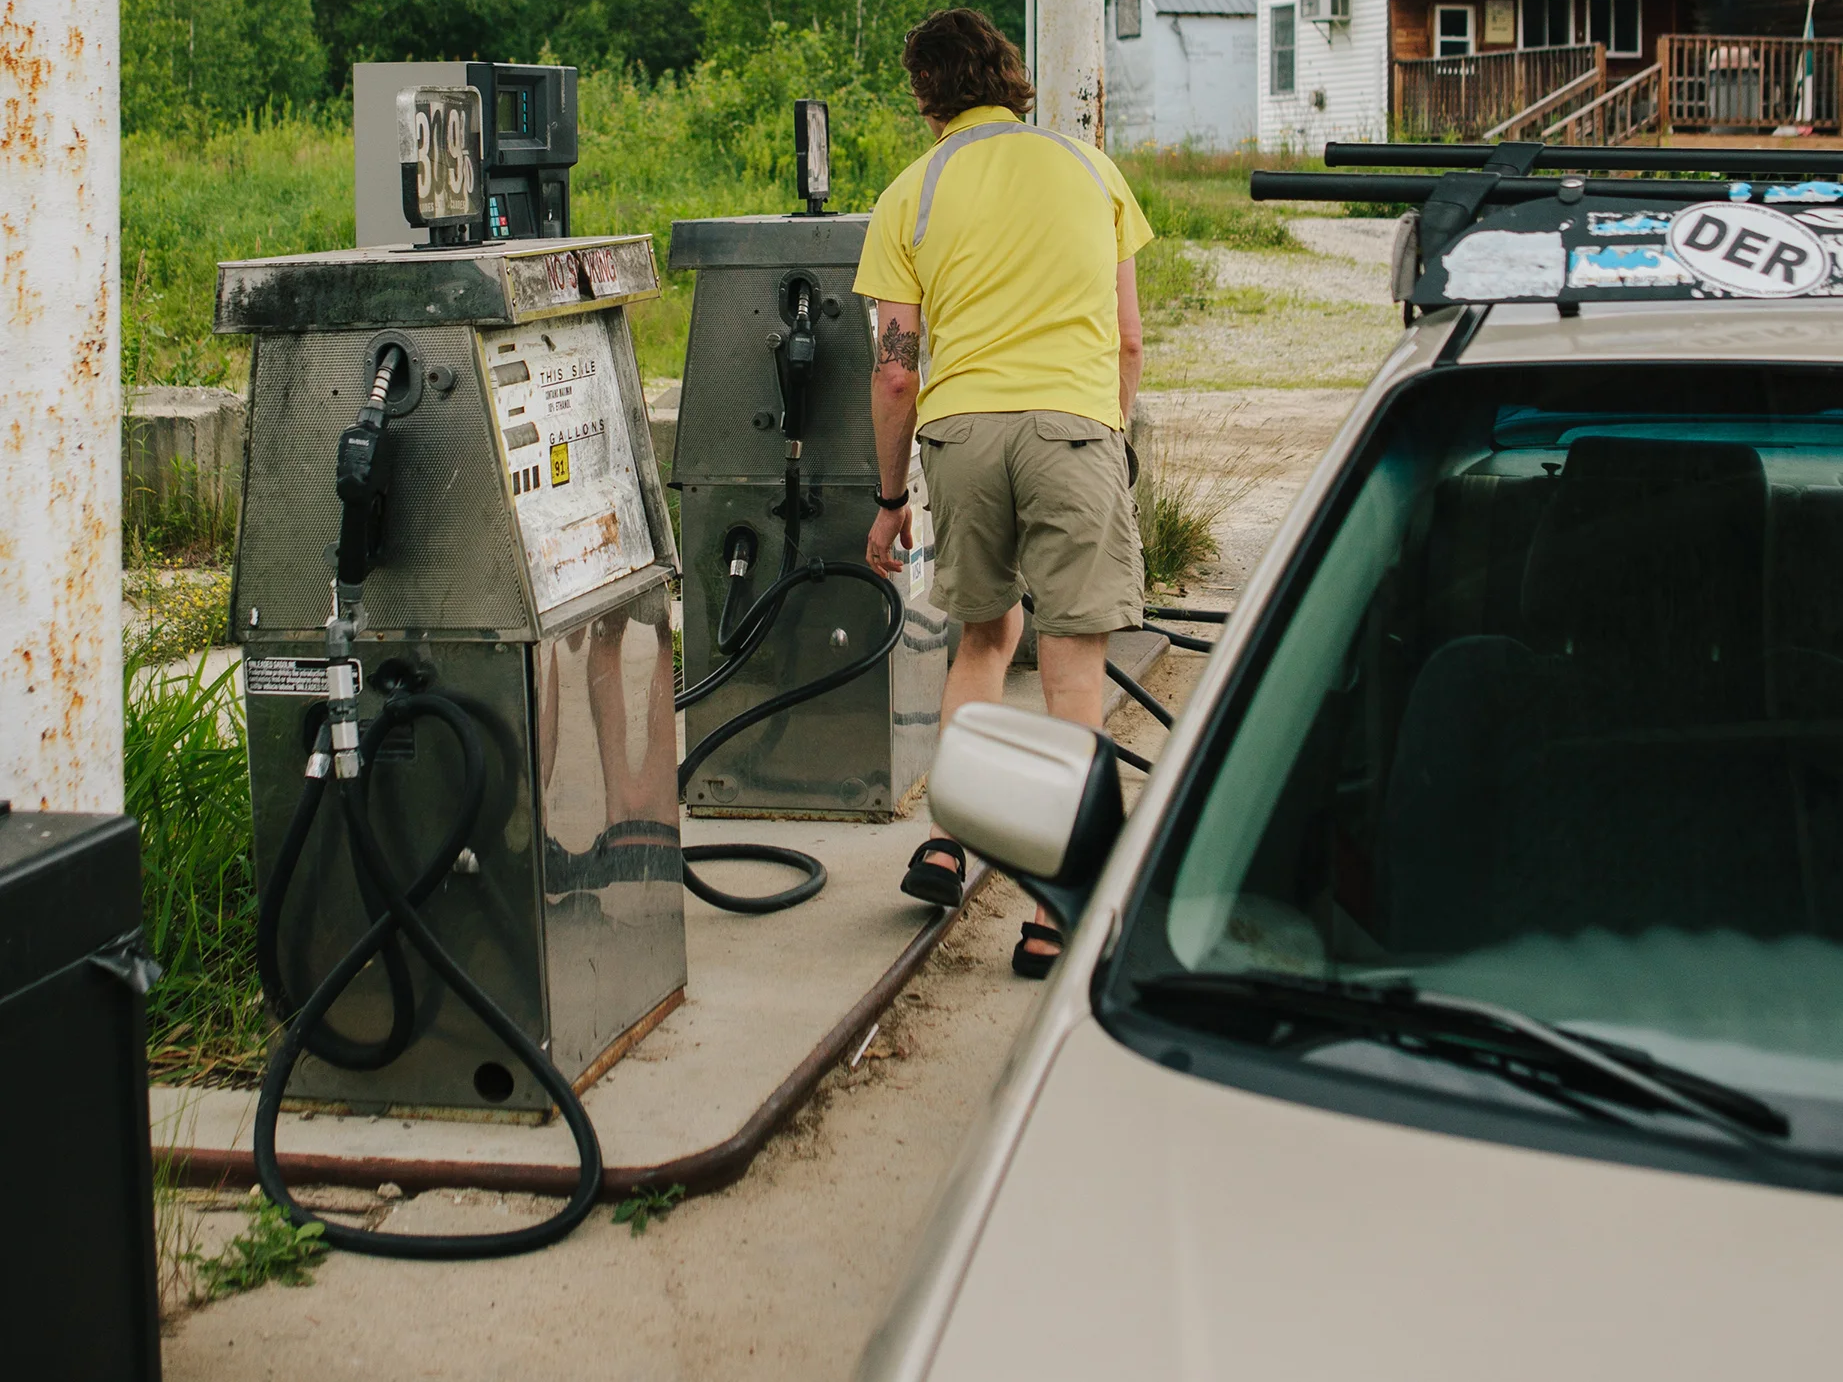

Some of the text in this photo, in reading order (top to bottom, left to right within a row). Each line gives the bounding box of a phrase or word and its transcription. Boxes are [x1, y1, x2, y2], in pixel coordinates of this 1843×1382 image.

[1683, 213, 1808, 285] DER
[545, 249, 618, 291] NO SOKING
[540, 368, 563, 384] THIS
[549, 418, 606, 445] GALLONS
[554, 459, 566, 477] 91
